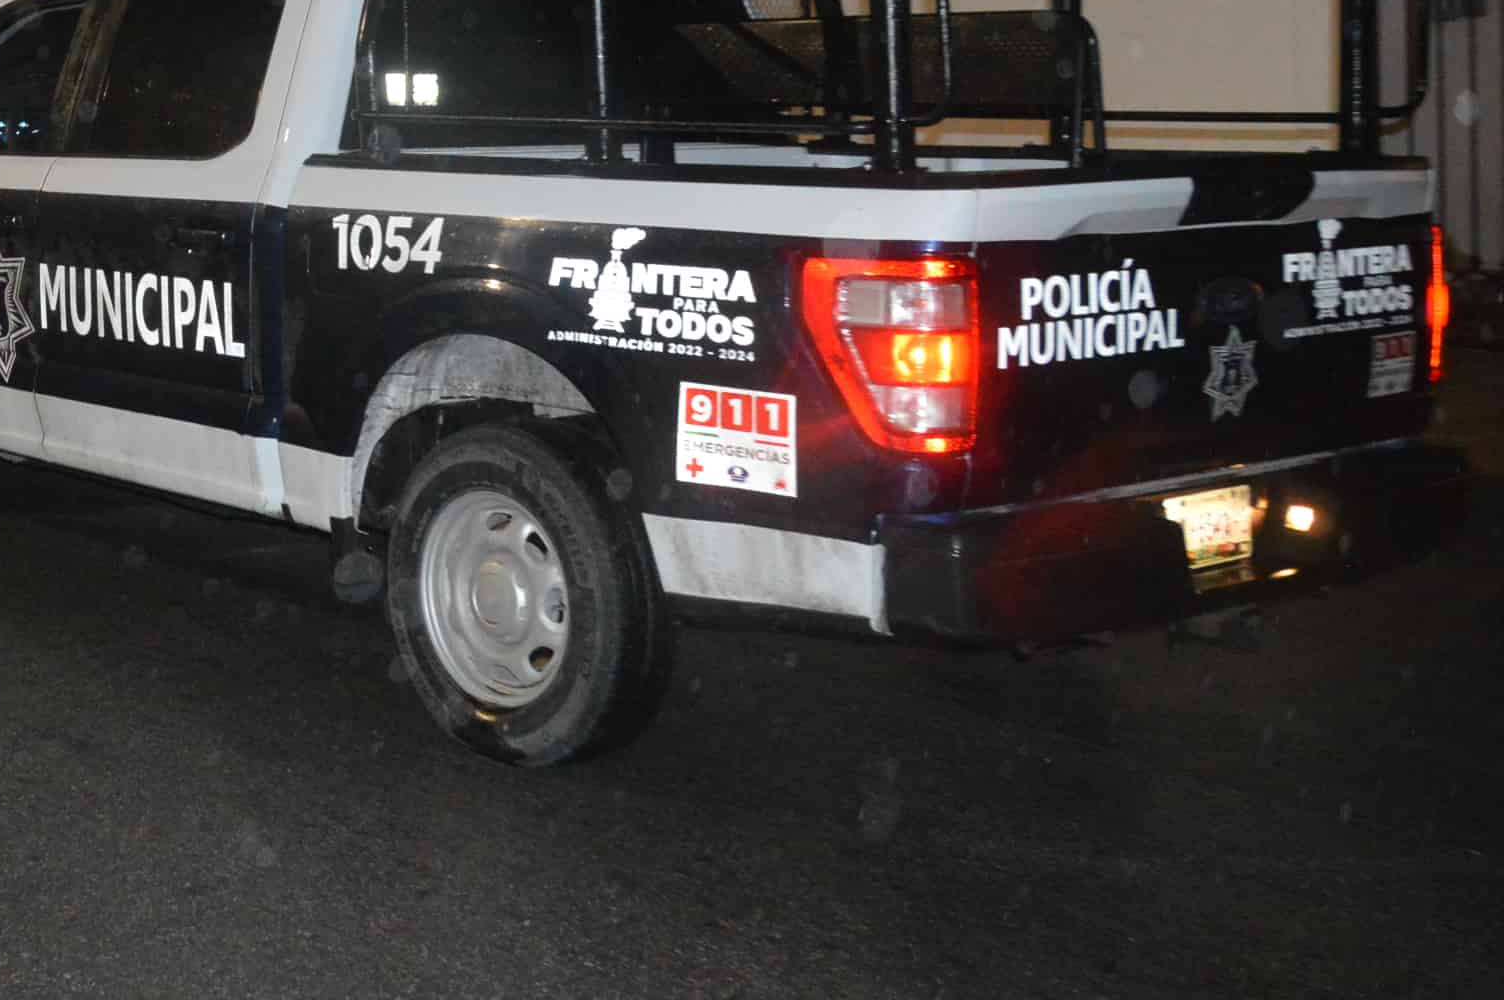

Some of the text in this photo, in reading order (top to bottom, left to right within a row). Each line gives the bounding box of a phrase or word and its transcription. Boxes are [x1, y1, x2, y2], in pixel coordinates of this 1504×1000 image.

[332, 213, 445, 274] 1054
[673, 297, 720, 314] PARA
[1020, 257, 1156, 321] POLICÍA
[1342, 284, 1414, 317] TODOS
[39, 262, 246, 358] MUNICIPAL
[634, 307, 755, 346] TODOS
[667, 342, 703, 357] 2022
[718, 348, 755, 363] 2024
[997, 308, 1185, 370] MUNICIPAL
[690, 393, 780, 431] 911
